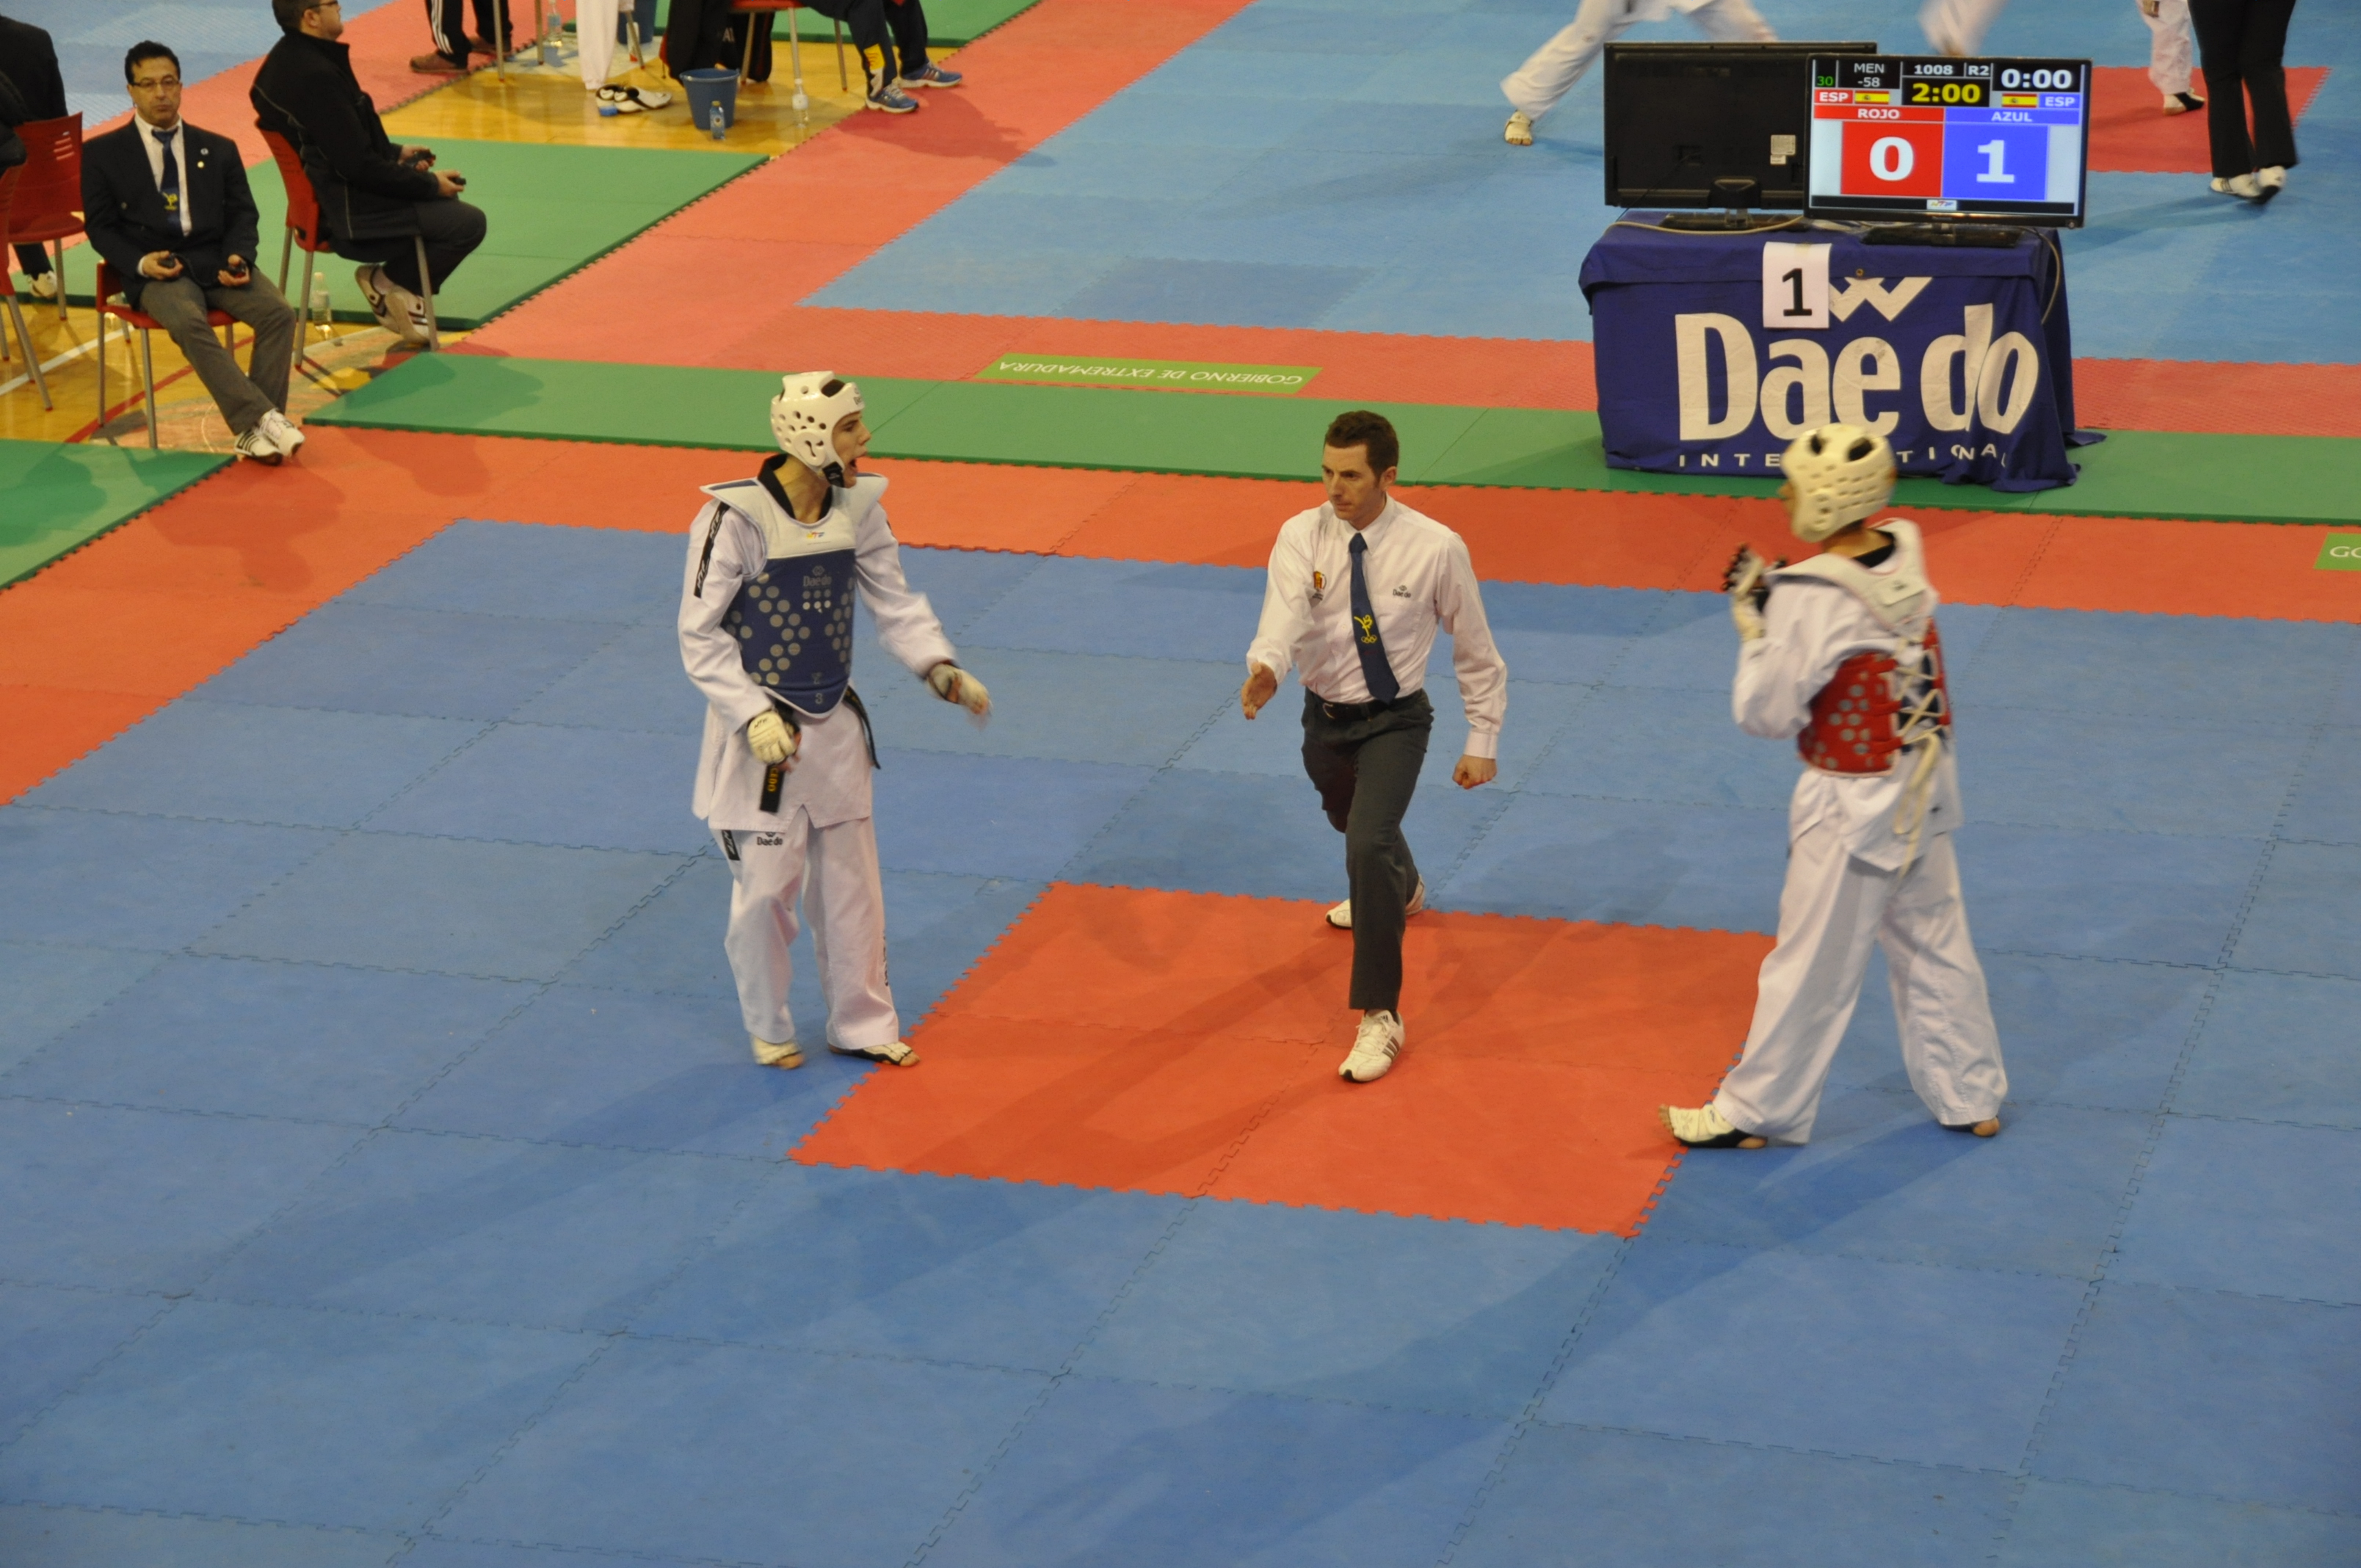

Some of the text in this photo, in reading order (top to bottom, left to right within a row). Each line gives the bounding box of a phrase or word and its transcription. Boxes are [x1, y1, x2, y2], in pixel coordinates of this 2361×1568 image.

[1854, 62, 1885, 73] MEN
[1914, 64, 1954, 76] 1008
[1968, 65, 1990, 76] R2
[1817, 76, 1834, 87] 30
[1857, 77, 1880, 87] -58
[2001, 68, 2072, 89] 0:00
[1818, 92, 1849, 102] ESP
[1912, 82, 1981, 104] 2:00
[2045, 96, 2075, 107] ESP
[1857, 108, 1901, 120] ROJO
[1991, 111, 2033, 123] AZUL
[1869, 136, 1915, 181] 0
[1976, 139, 2015, 184] 1
[1781, 267, 1813, 317] 1
[1000, 361, 1303, 385] GOBIERNO DE EXTREMADURA
[1674, 302, 2039, 442] Daedo
[756, 836, 783, 846] Daedo
